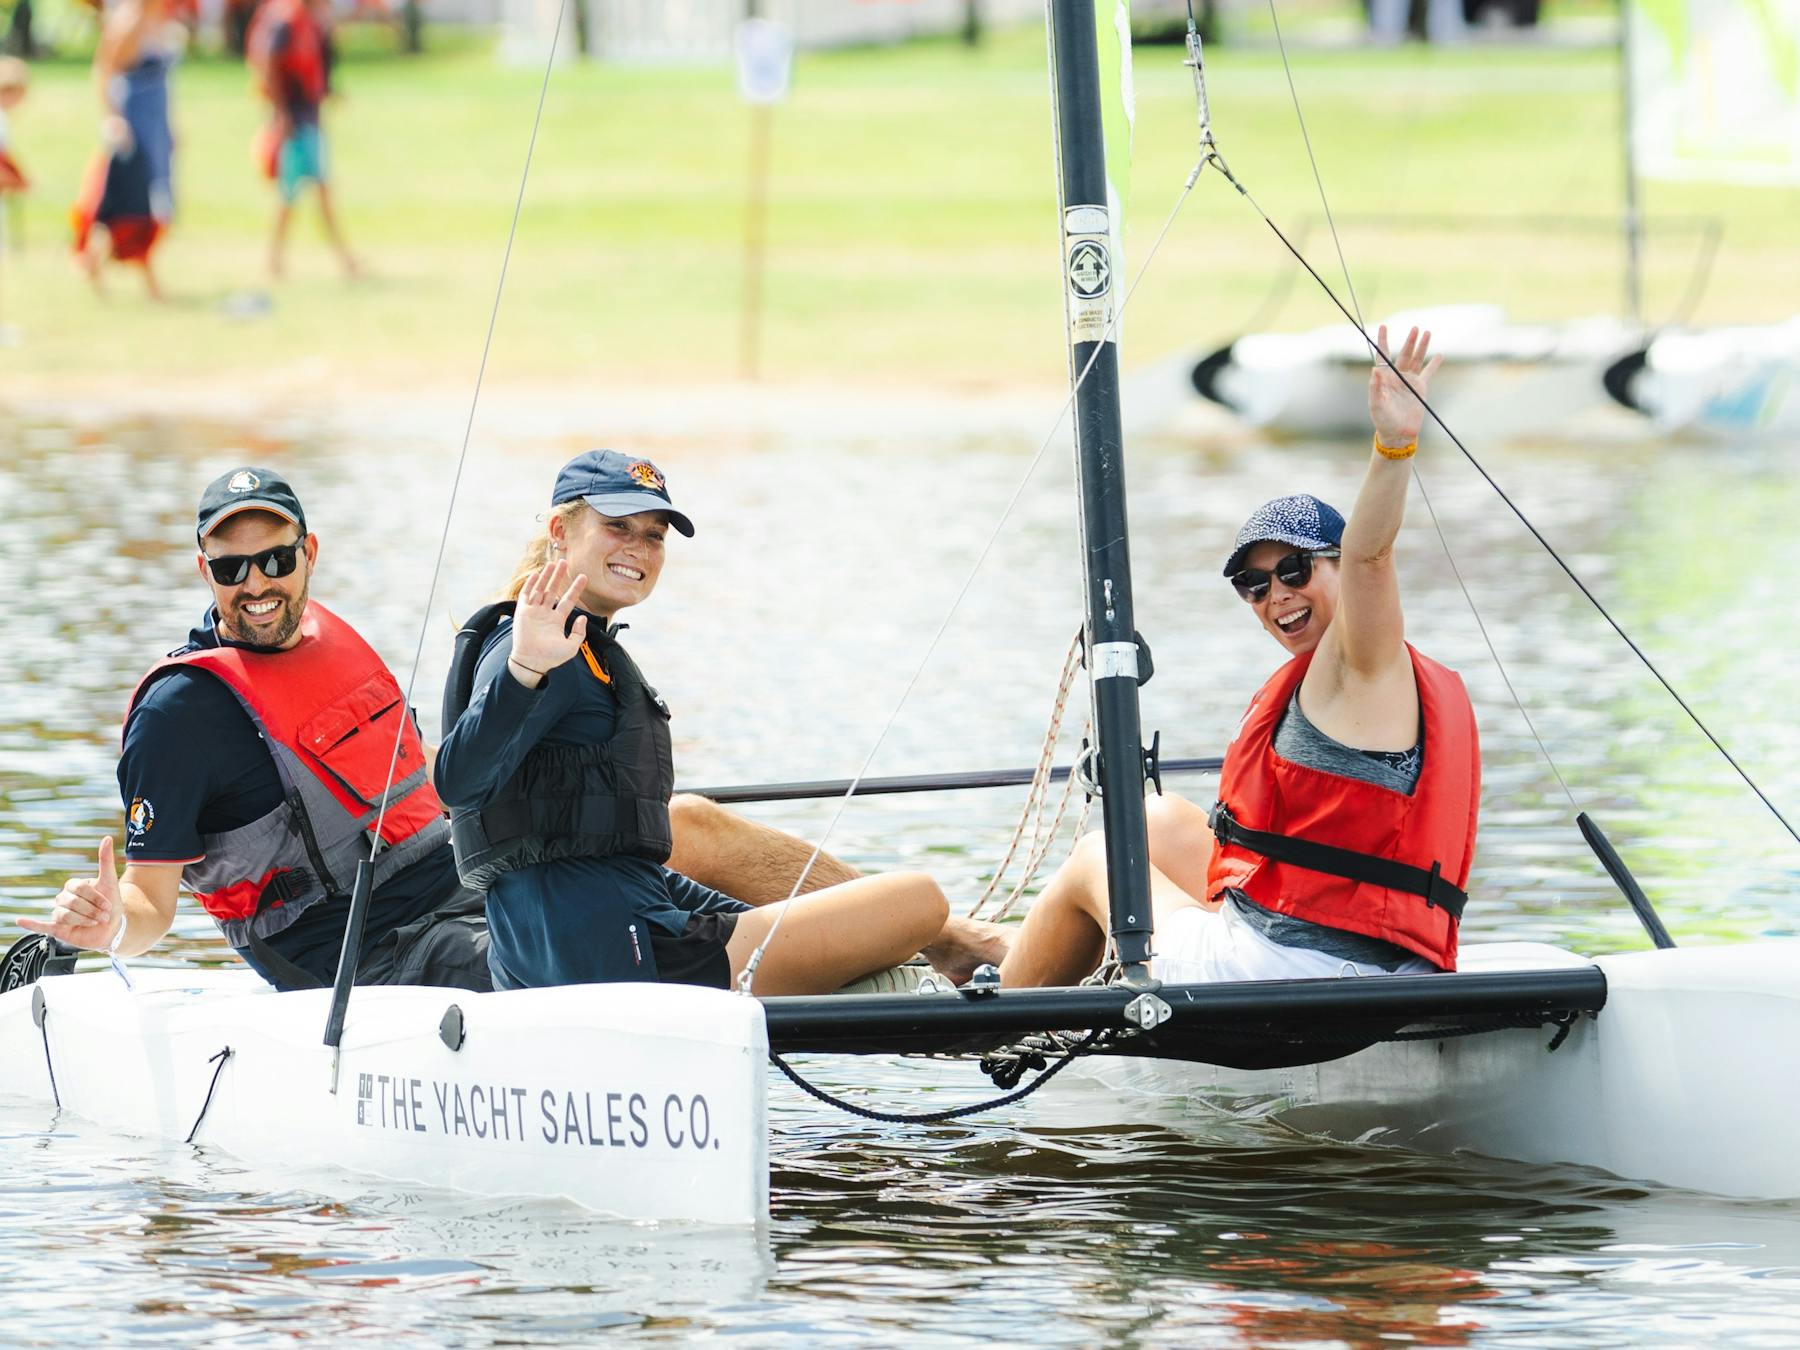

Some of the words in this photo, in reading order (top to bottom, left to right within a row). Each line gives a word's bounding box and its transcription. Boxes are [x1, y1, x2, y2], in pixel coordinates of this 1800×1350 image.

[378, 1075, 427, 1132] THE
[433, 1081, 527, 1142] YACHT
[541, 1089, 649, 1148] SALES
[664, 1093, 720, 1150] CO.
